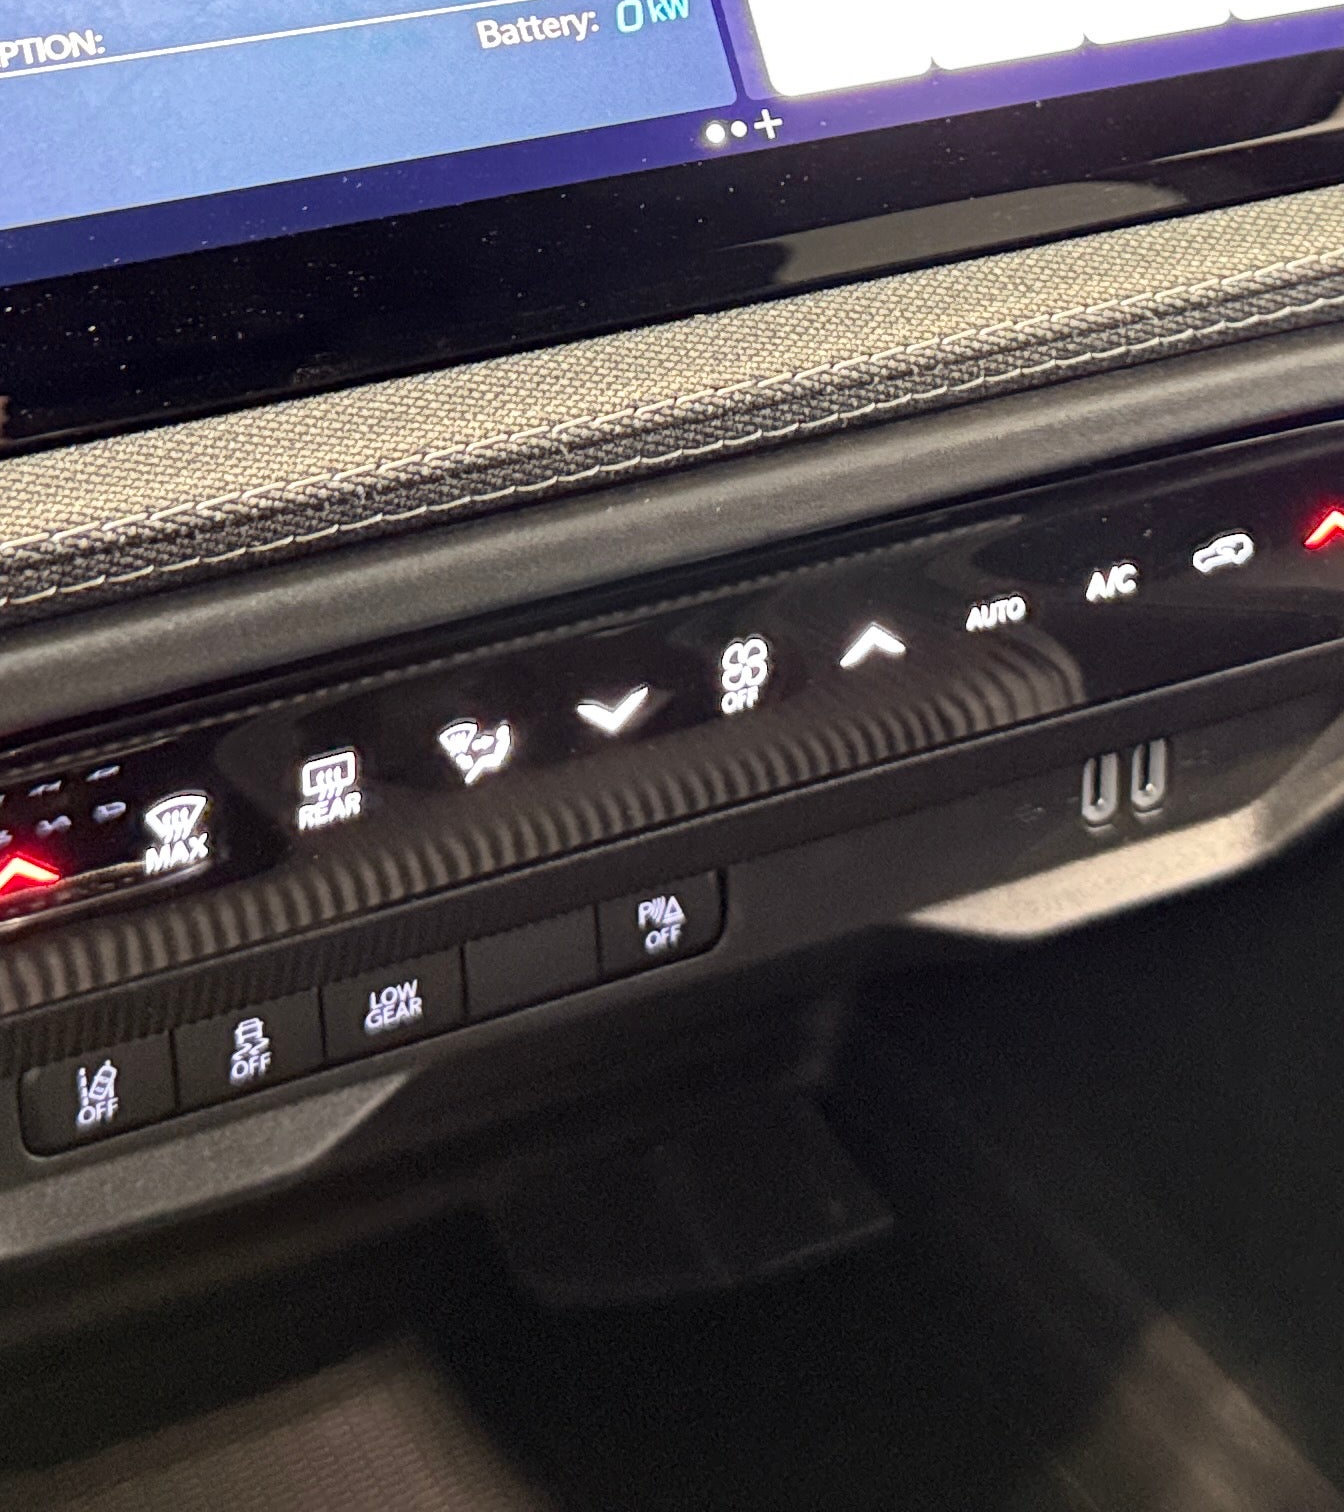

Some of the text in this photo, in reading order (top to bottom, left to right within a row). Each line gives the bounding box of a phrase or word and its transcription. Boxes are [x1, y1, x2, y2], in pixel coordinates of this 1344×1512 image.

[475, 9, 600, 50] Battery:
[1085, 559, 1141, 603] A/C
[965, 592, 1027, 632] AUTO
[719, 683, 761, 715] OFF
[297, 789, 363, 831] REAR
[144, 829, 210, 873] MAX
[644, 923, 683, 953] OFF
[368, 977, 420, 1011] LOW
[364, 996, 424, 1033] GEAR
[229, 1051, 273, 1083] OFF
[75, 1096, 119, 1127] OFF
